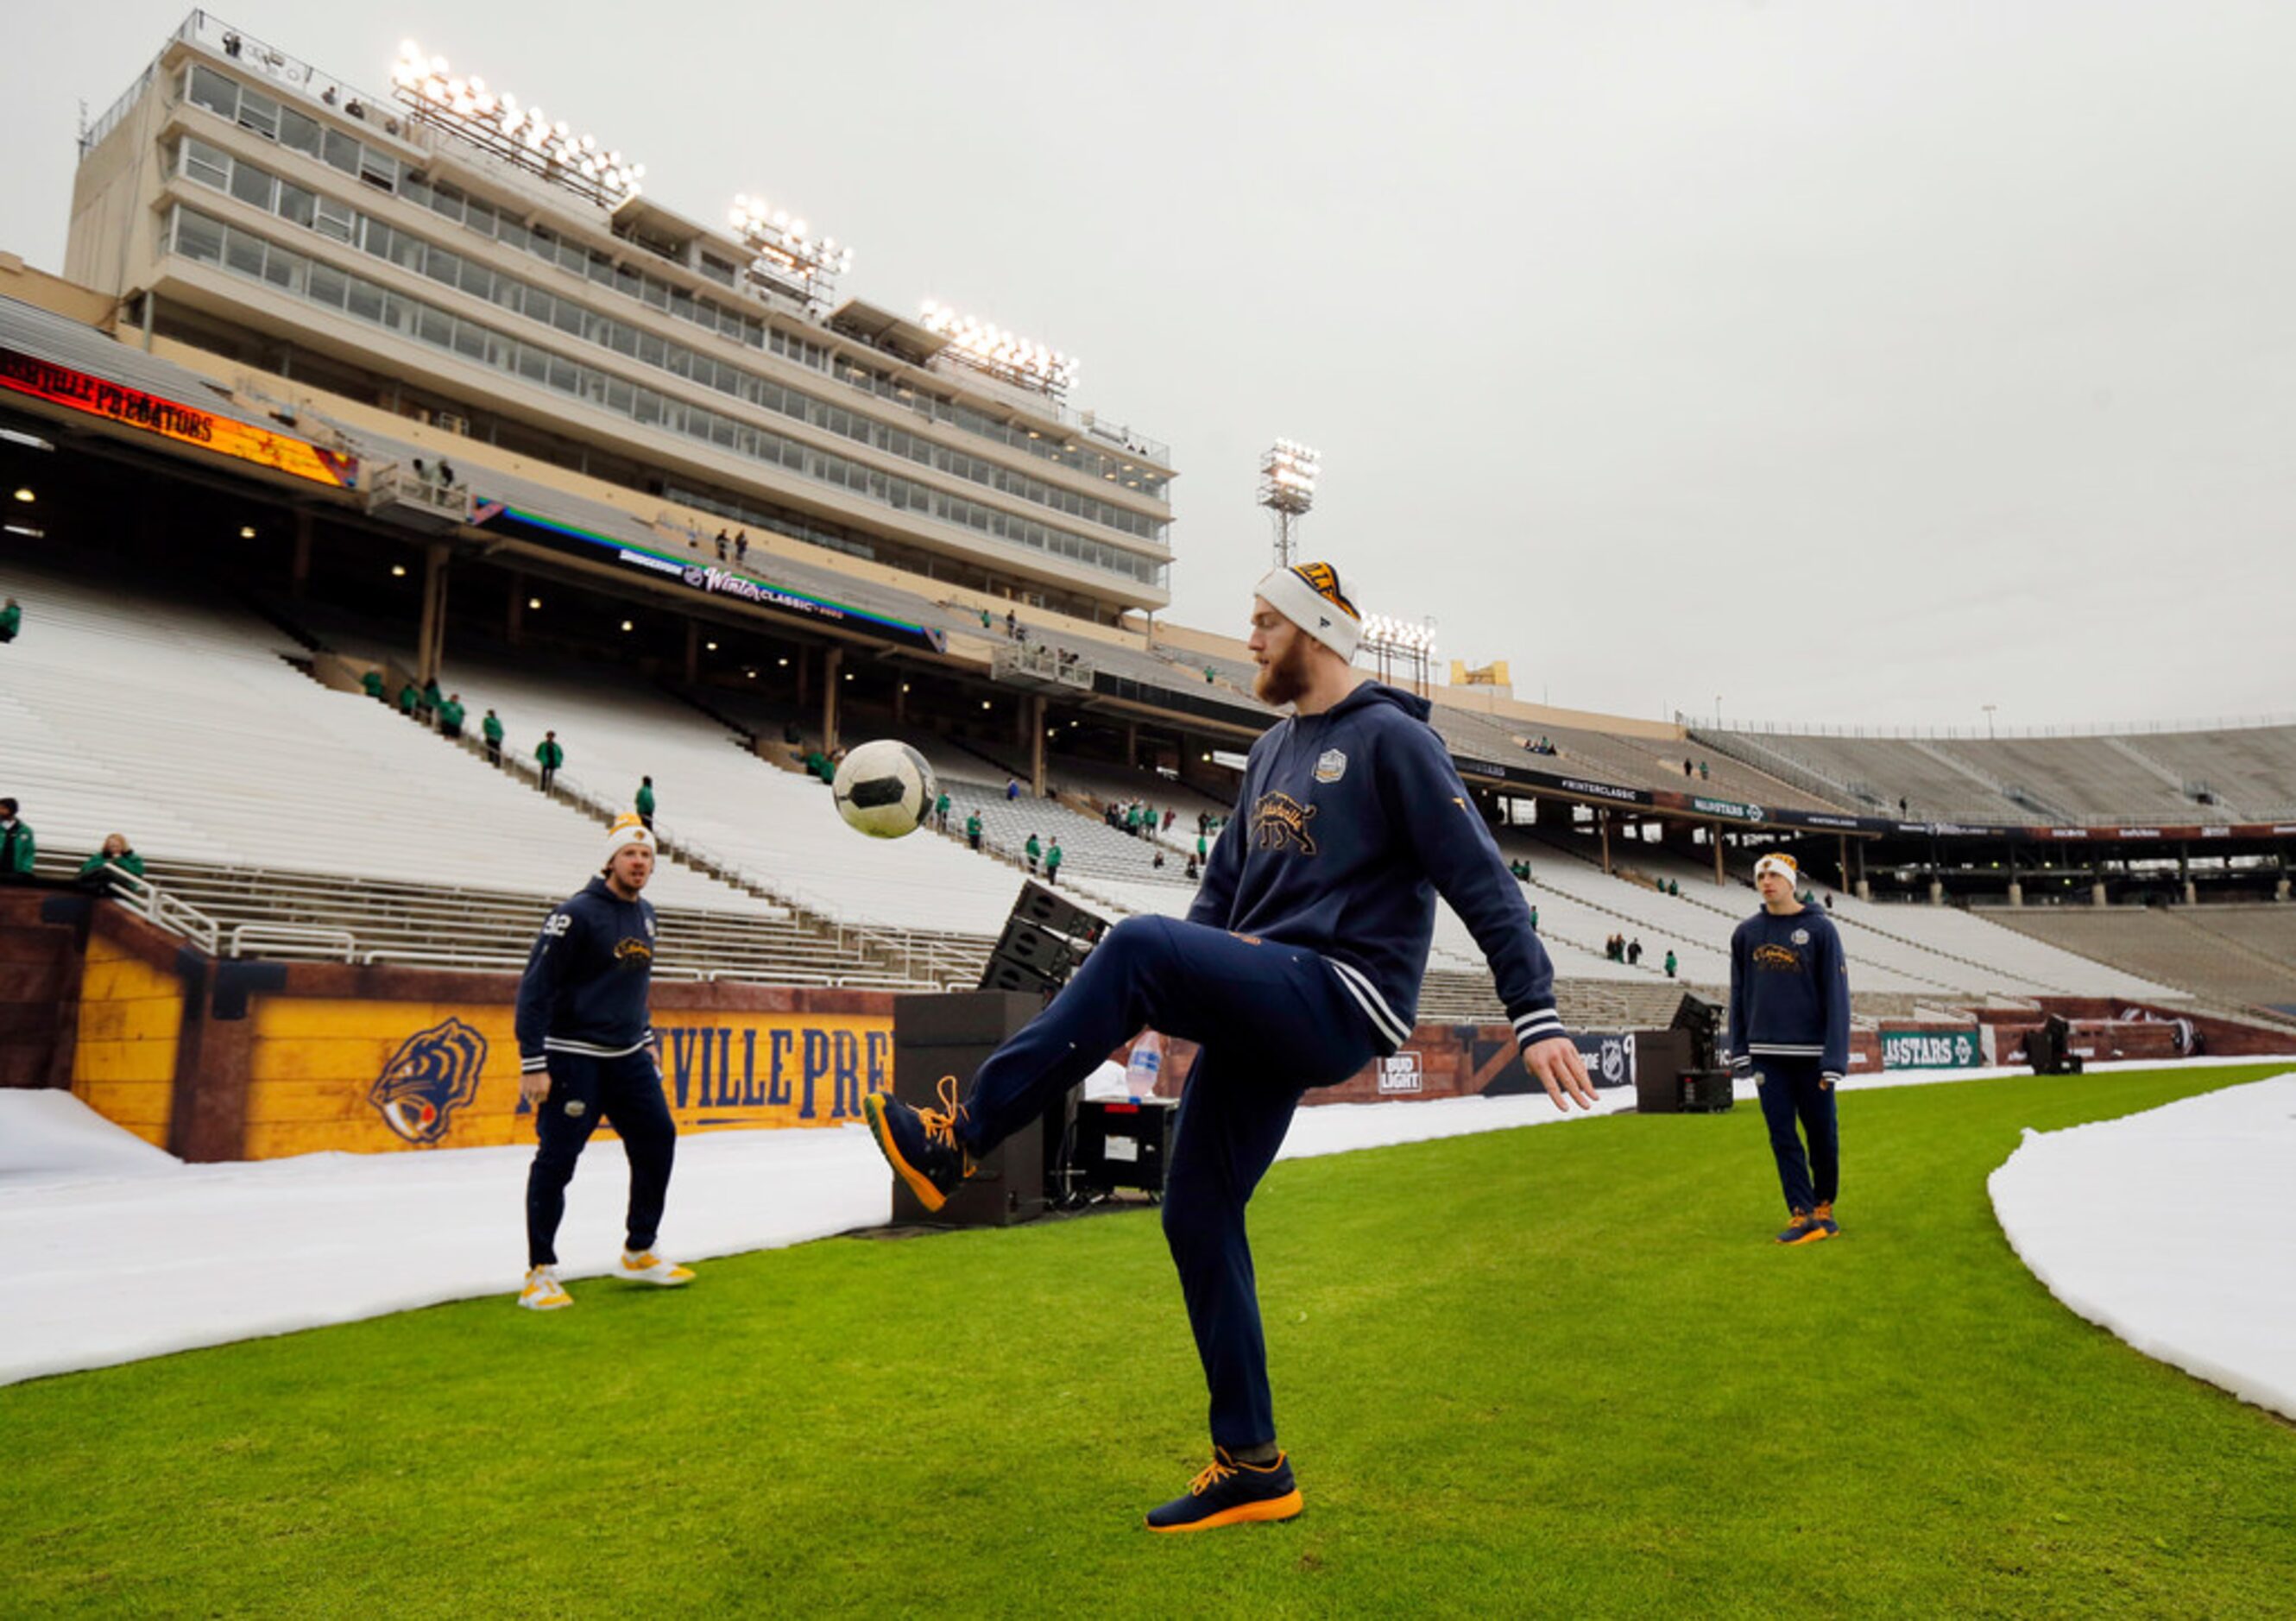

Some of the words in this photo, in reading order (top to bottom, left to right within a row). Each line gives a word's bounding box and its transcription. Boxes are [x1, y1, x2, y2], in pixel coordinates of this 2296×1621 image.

[704, 566, 760, 601] Winter
[760, 590, 813, 613] CLASSIC
[1385, 1057, 1413, 1072] BUD
[1901, 1037, 1952, 1066] STARS
[798, 1028, 894, 1119] PRE
[1382, 1073, 1418, 1088] LIGHT
